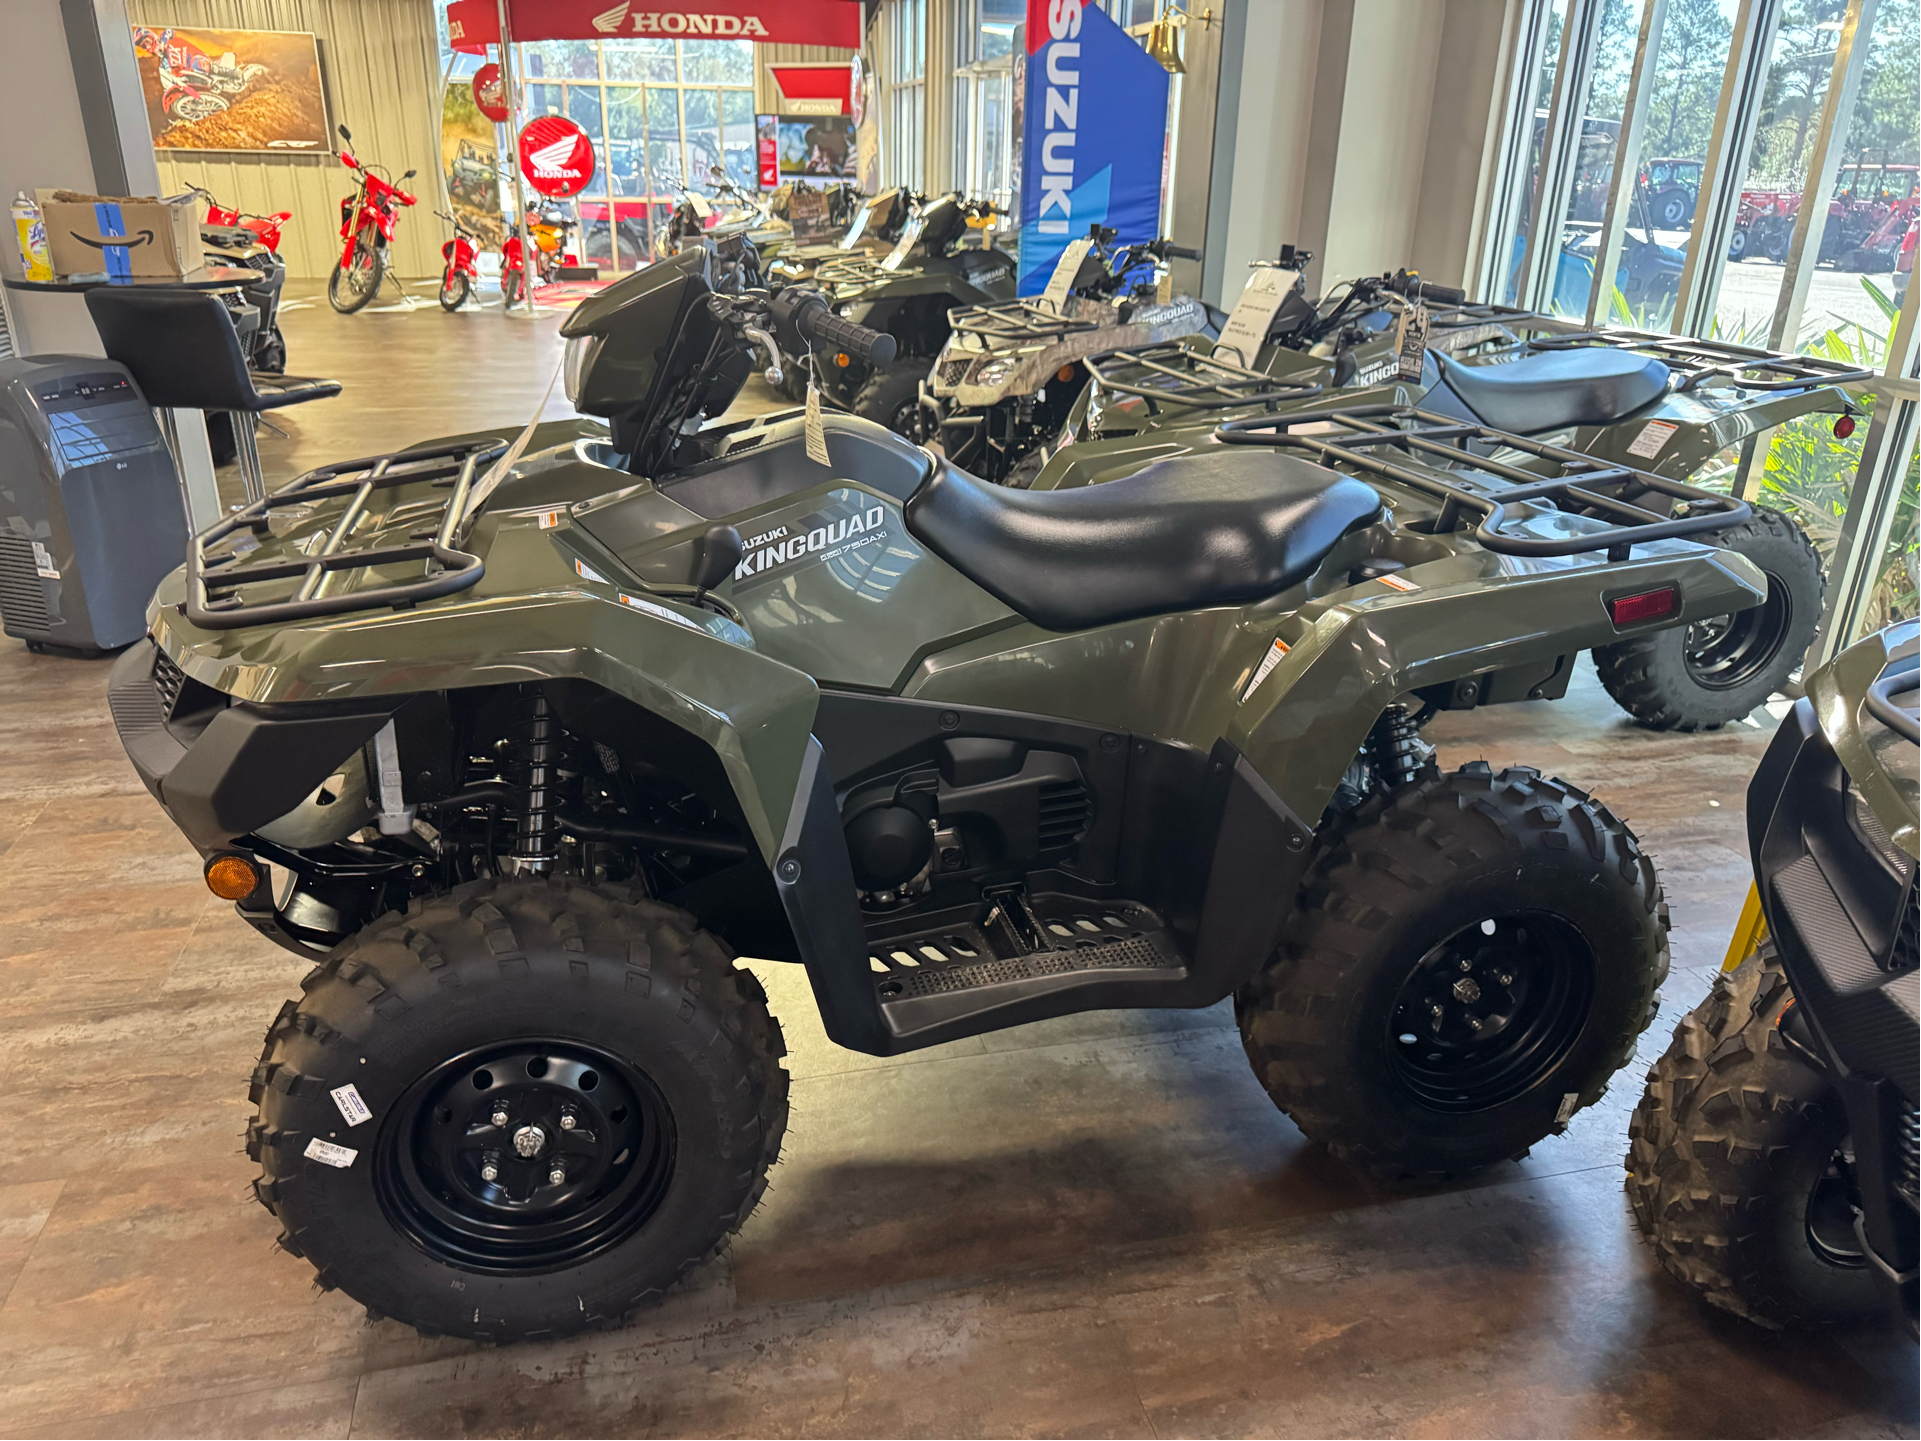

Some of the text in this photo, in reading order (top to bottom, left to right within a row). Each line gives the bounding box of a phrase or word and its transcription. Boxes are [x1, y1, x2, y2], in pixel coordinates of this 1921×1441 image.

[631, 12, 770, 36] HONDA
[1037, 0, 1083, 234] SUZUKI
[533, 168, 583, 179] HONDA
[735, 506, 884, 581] KINGQUAD
